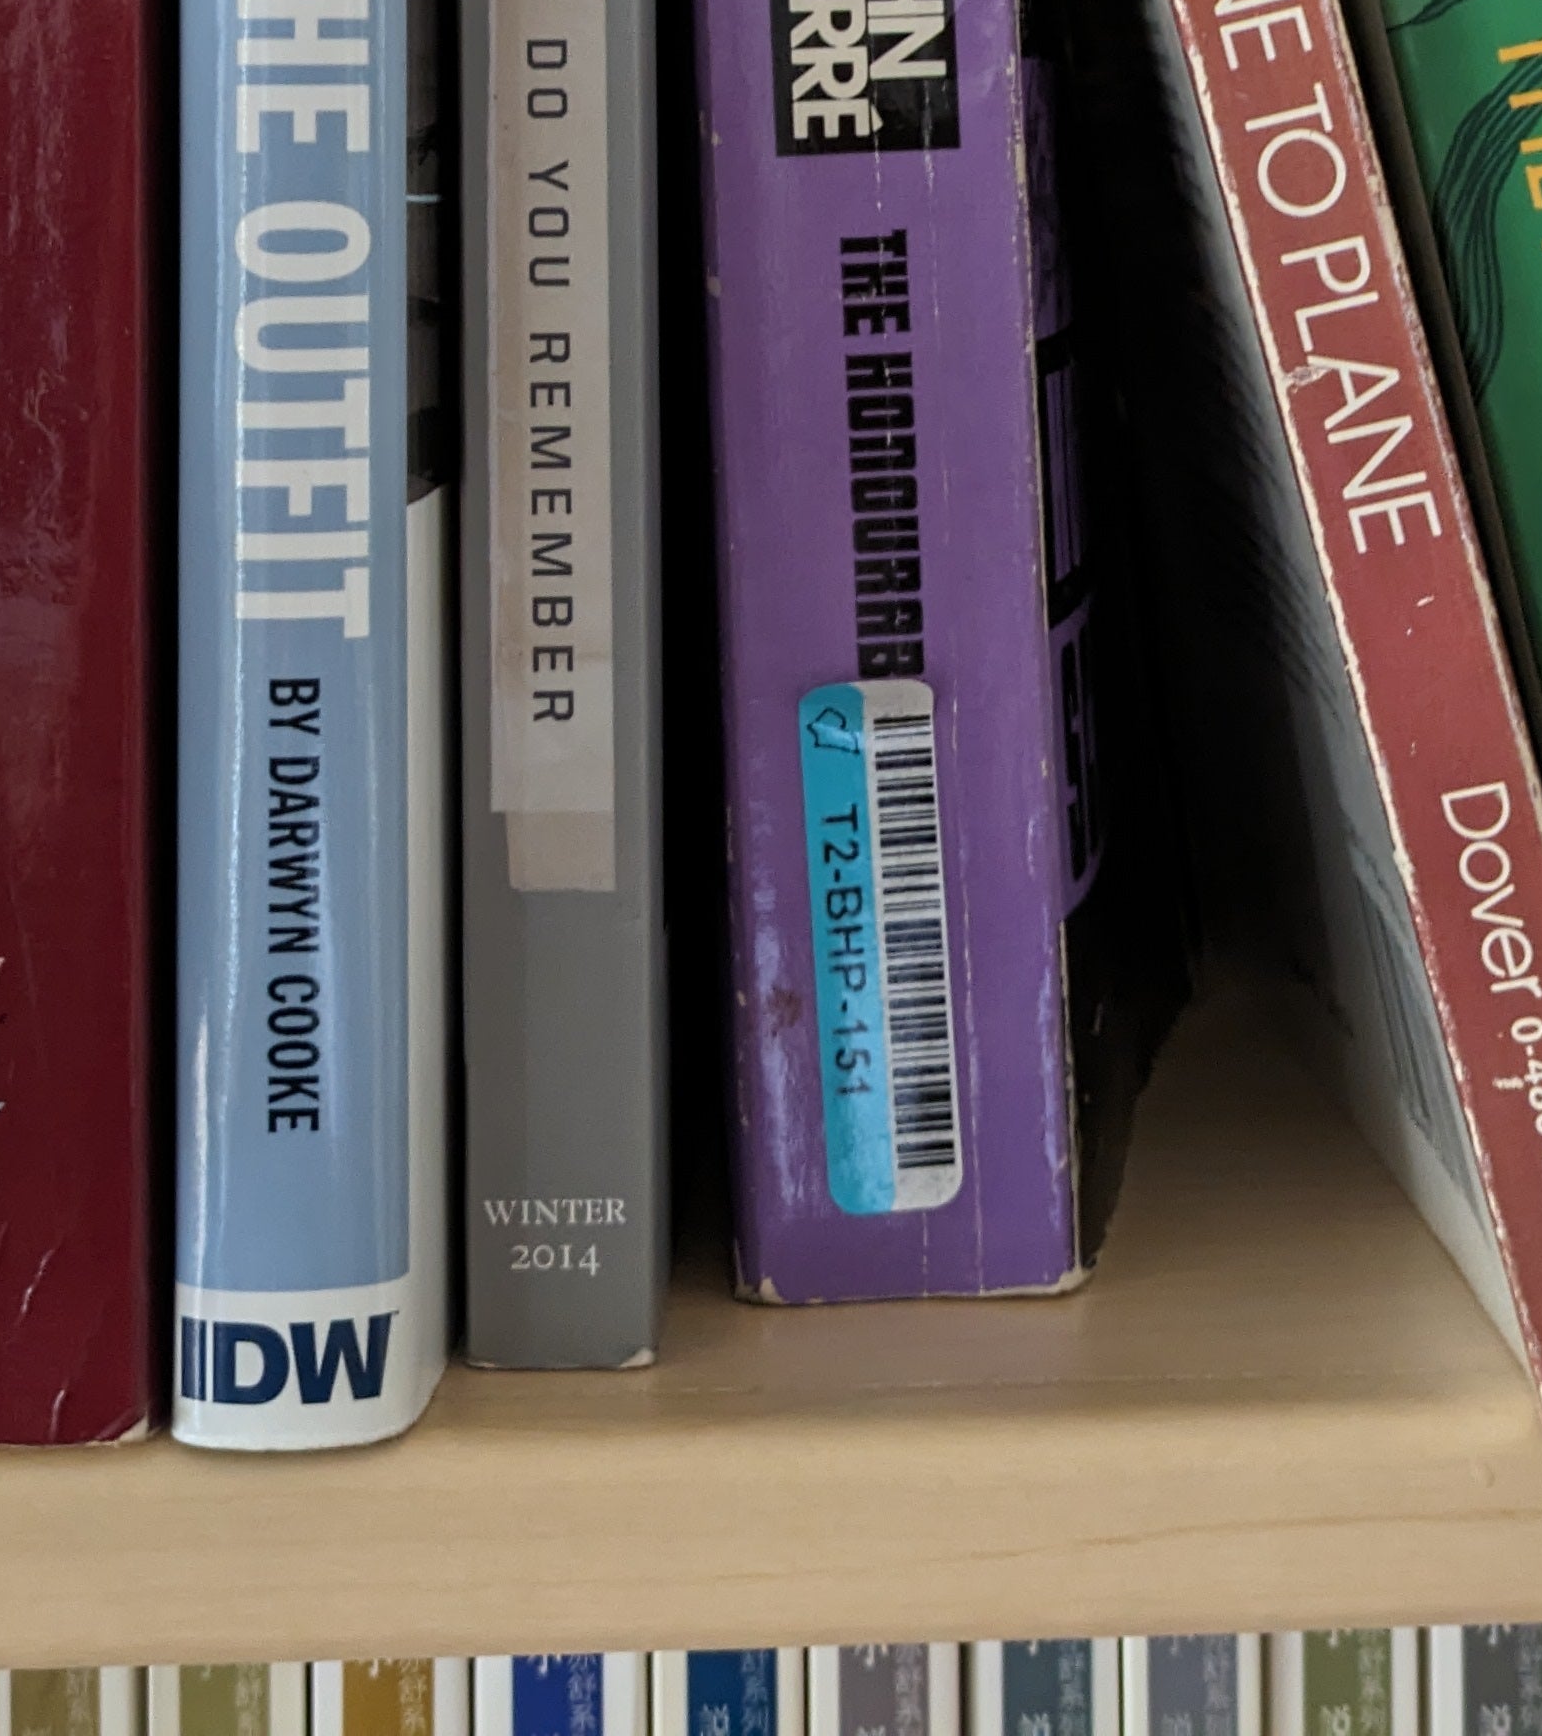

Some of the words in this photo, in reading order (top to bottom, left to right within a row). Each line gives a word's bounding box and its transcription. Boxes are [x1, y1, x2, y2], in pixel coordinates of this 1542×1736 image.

[526, 37, 569, 121] DO
[1245, 82, 1347, 219] TO
[527, 160, 572, 288] YOU
[840, 228, 912, 337] THE
[234, 201, 371, 640] OUTFIT
[1280, 235, 1442, 554] PLANE
[528, 331, 576, 724] REMEMBER
[268, 677, 322, 736] BY
[267, 758, 323, 955] DARWYN
[820, 803, 873, 1097] T2-BHP-151
[267, 974, 322, 1135] COOKE
[483, 1198, 627, 1227] WINTER
[510, 1244, 601, 1278] 2014
[179, 1313, 394, 1406] IDW
